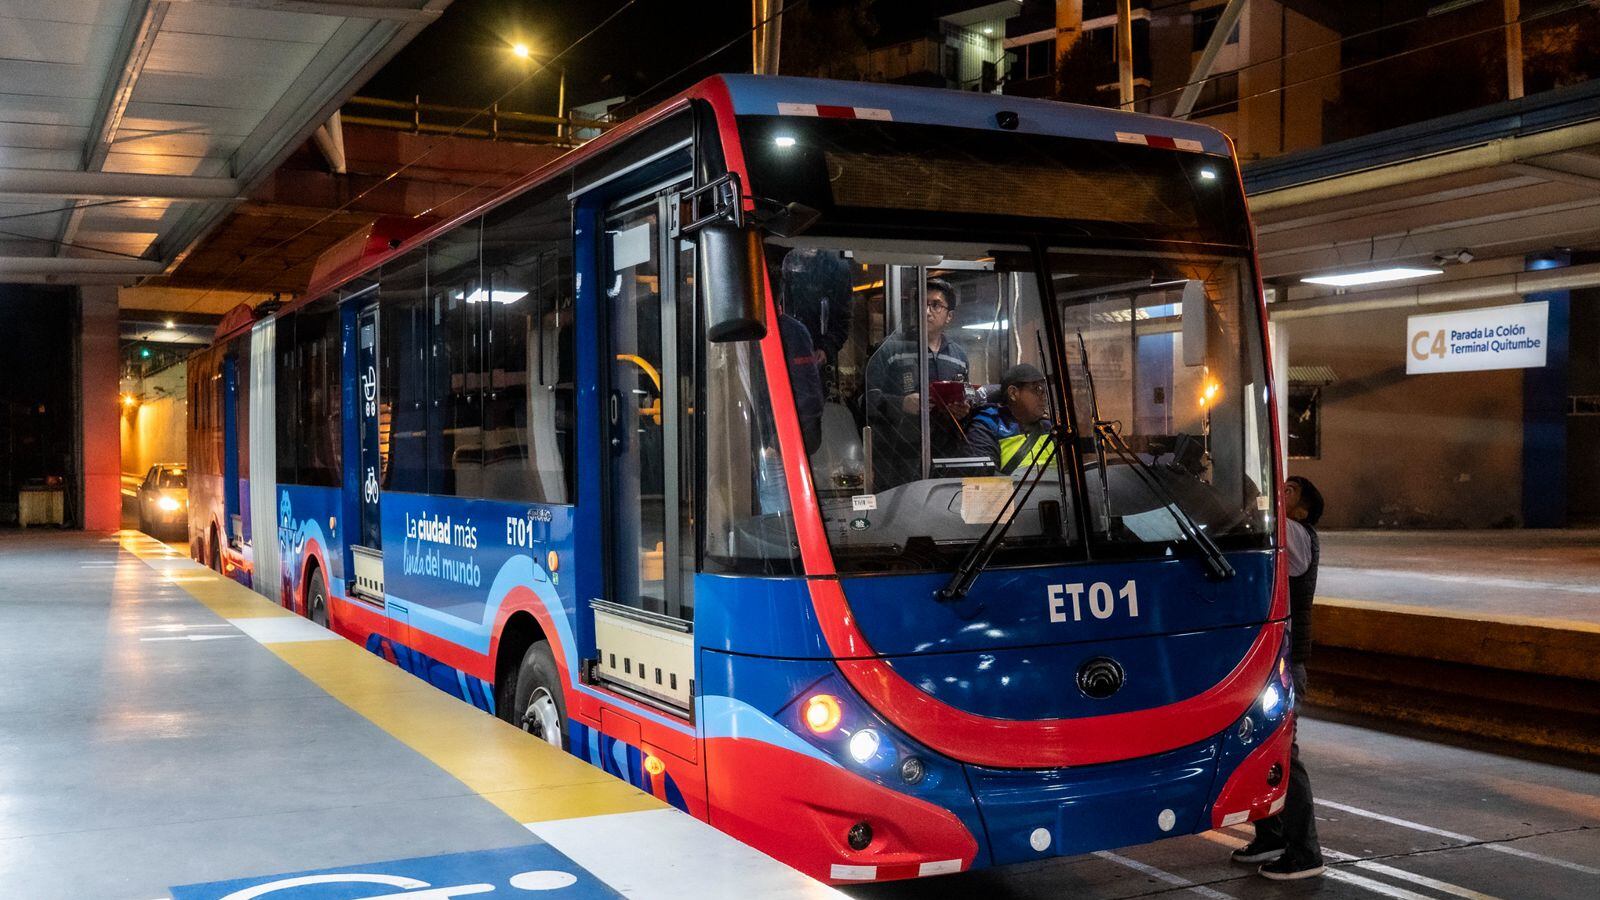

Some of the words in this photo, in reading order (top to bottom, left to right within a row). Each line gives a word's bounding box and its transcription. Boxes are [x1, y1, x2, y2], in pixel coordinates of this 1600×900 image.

[1411, 329, 1447, 361] C4
[1451, 328, 1482, 341] Parada
[1484, 328, 1494, 338] La
[1496, 324, 1526, 337] Colón
[1451, 341, 1489, 354] Terminal
[1491, 337, 1541, 353] Quitumbe
[406, 512, 417, 539] La
[418, 511, 451, 545] ciudad
[454, 518, 477, 550] más
[507, 516, 533, 549] ET01
[425, 548, 440, 579] del
[442, 556, 481, 588] mundo
[1048, 580, 1139, 623] ET01
